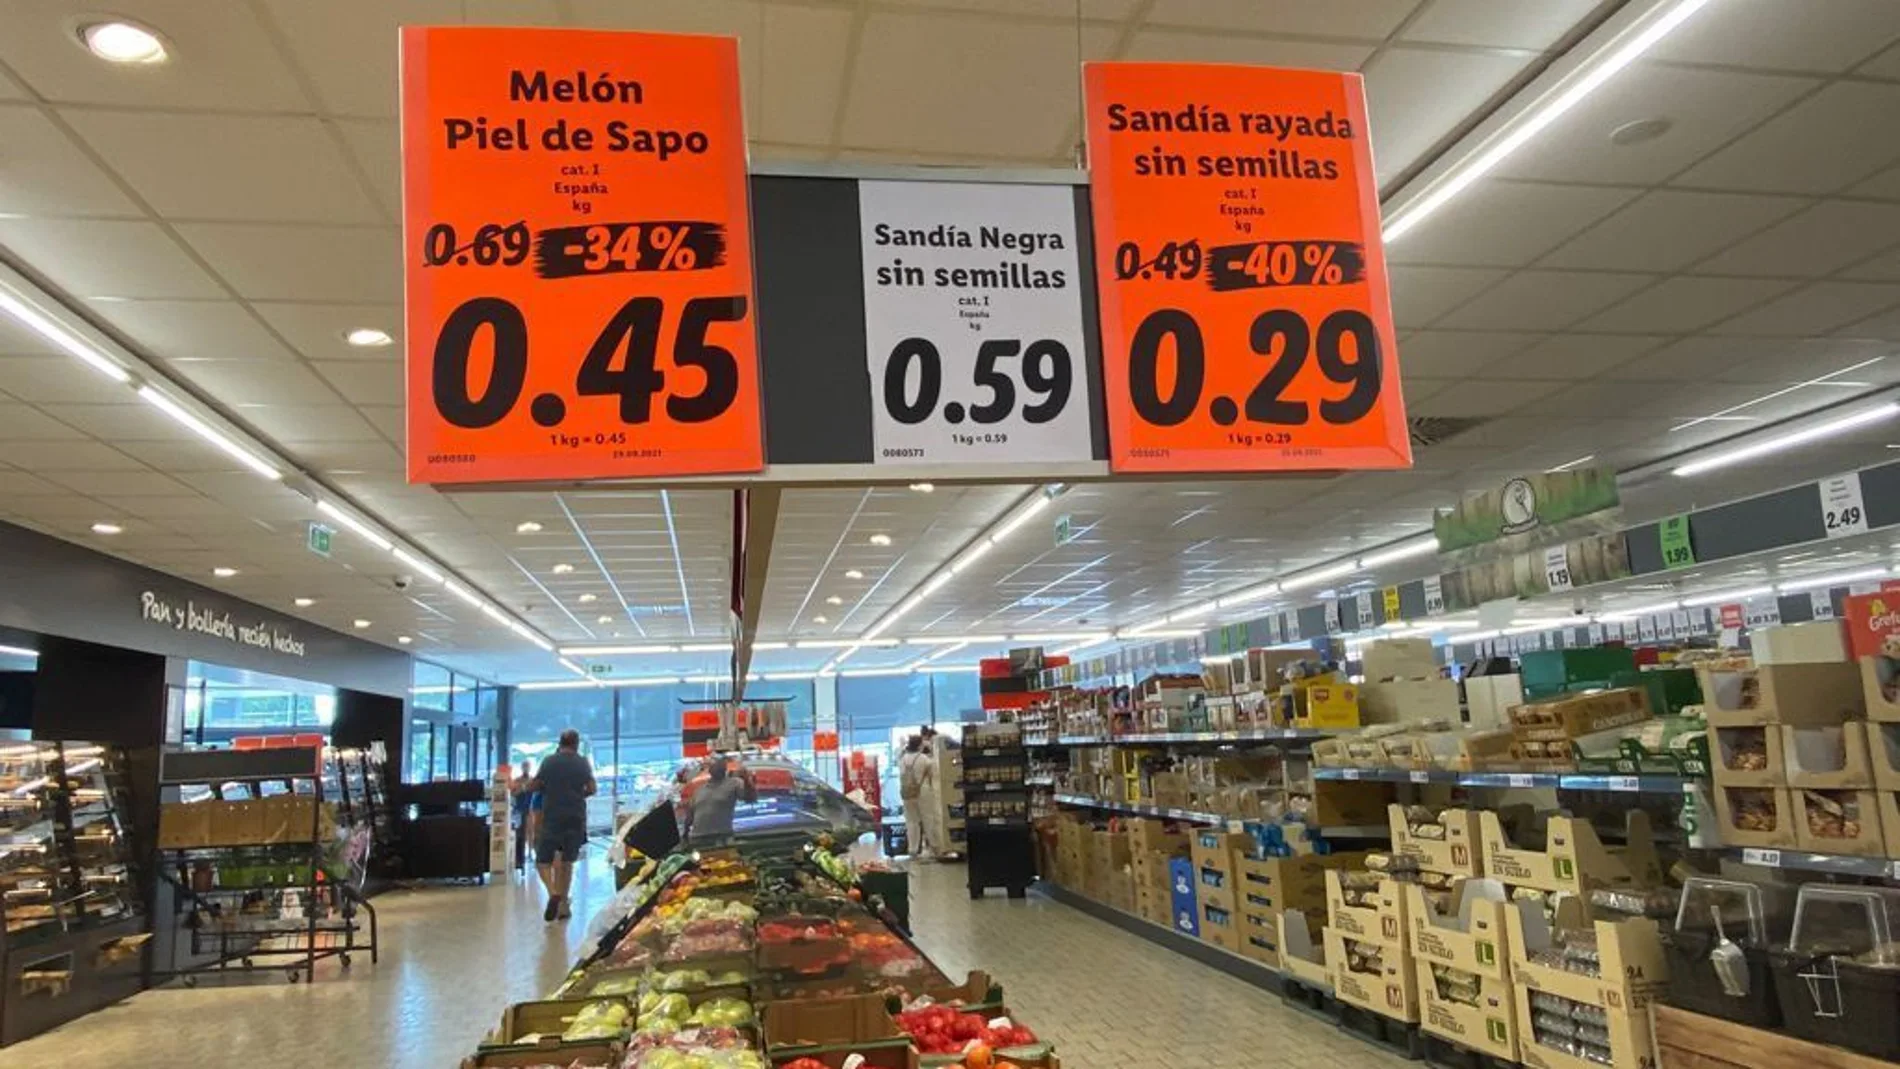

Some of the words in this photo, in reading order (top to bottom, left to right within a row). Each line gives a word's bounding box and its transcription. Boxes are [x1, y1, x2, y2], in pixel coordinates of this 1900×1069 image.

[510, 70, 643, 104] Melón
[1108, 104, 1231, 132] Sandía
[1240, 110, 1354, 141] rayada
[444, 117, 529, 150] Piel
[541, 119, 593, 151] de
[607, 120, 708, 160] Sapo
[561, 165, 589, 176] cat.
[593, 164, 599, 175] I
[1135, 146, 1185, 176] sin
[1198, 149, 1339, 180] semillas
[554, 182, 608, 195] España
[1225, 190, 1248, 199] cat.
[1251, 189, 1256, 199] I
[572, 200, 592, 213] kg
[1220, 205, 1264, 216] España
[874, 224, 972, 247] Sandía
[980, 226, 1064, 255] Negra
[1235, 221, 1251, 233] kg
[423, 221, 530, 267] 0.69
[1115, 239, 1202, 280] 0.49
[877, 259, 924, 286] sin
[934, 262, 1065, 288] semillas
[959, 296, 980, 306] cat.
[983, 296, 989, 305] I
[969, 322, 980, 331] kg
[432, 295, 747, 428] 0.45
[1129, 308, 1383, 426] 0.29
[884, 338, 1072, 424] 0.59
[550, 435, 557, 445] 1
[561, 434, 579, 448] kg
[595, 433, 626, 445] 0.45
[952, 434, 957, 443] 1
[960, 434, 973, 446] kg
[985, 434, 1008, 443] 0.59
[1236, 434, 1252, 446] kg
[1265, 433, 1291, 444] 0.29
[1826, 506, 1860, 529] 2.49
[141, 591, 171, 623] Pan
[175, 607, 184, 629] y
[188, 601, 235, 641] bollería
[239, 623, 271, 649] recién
